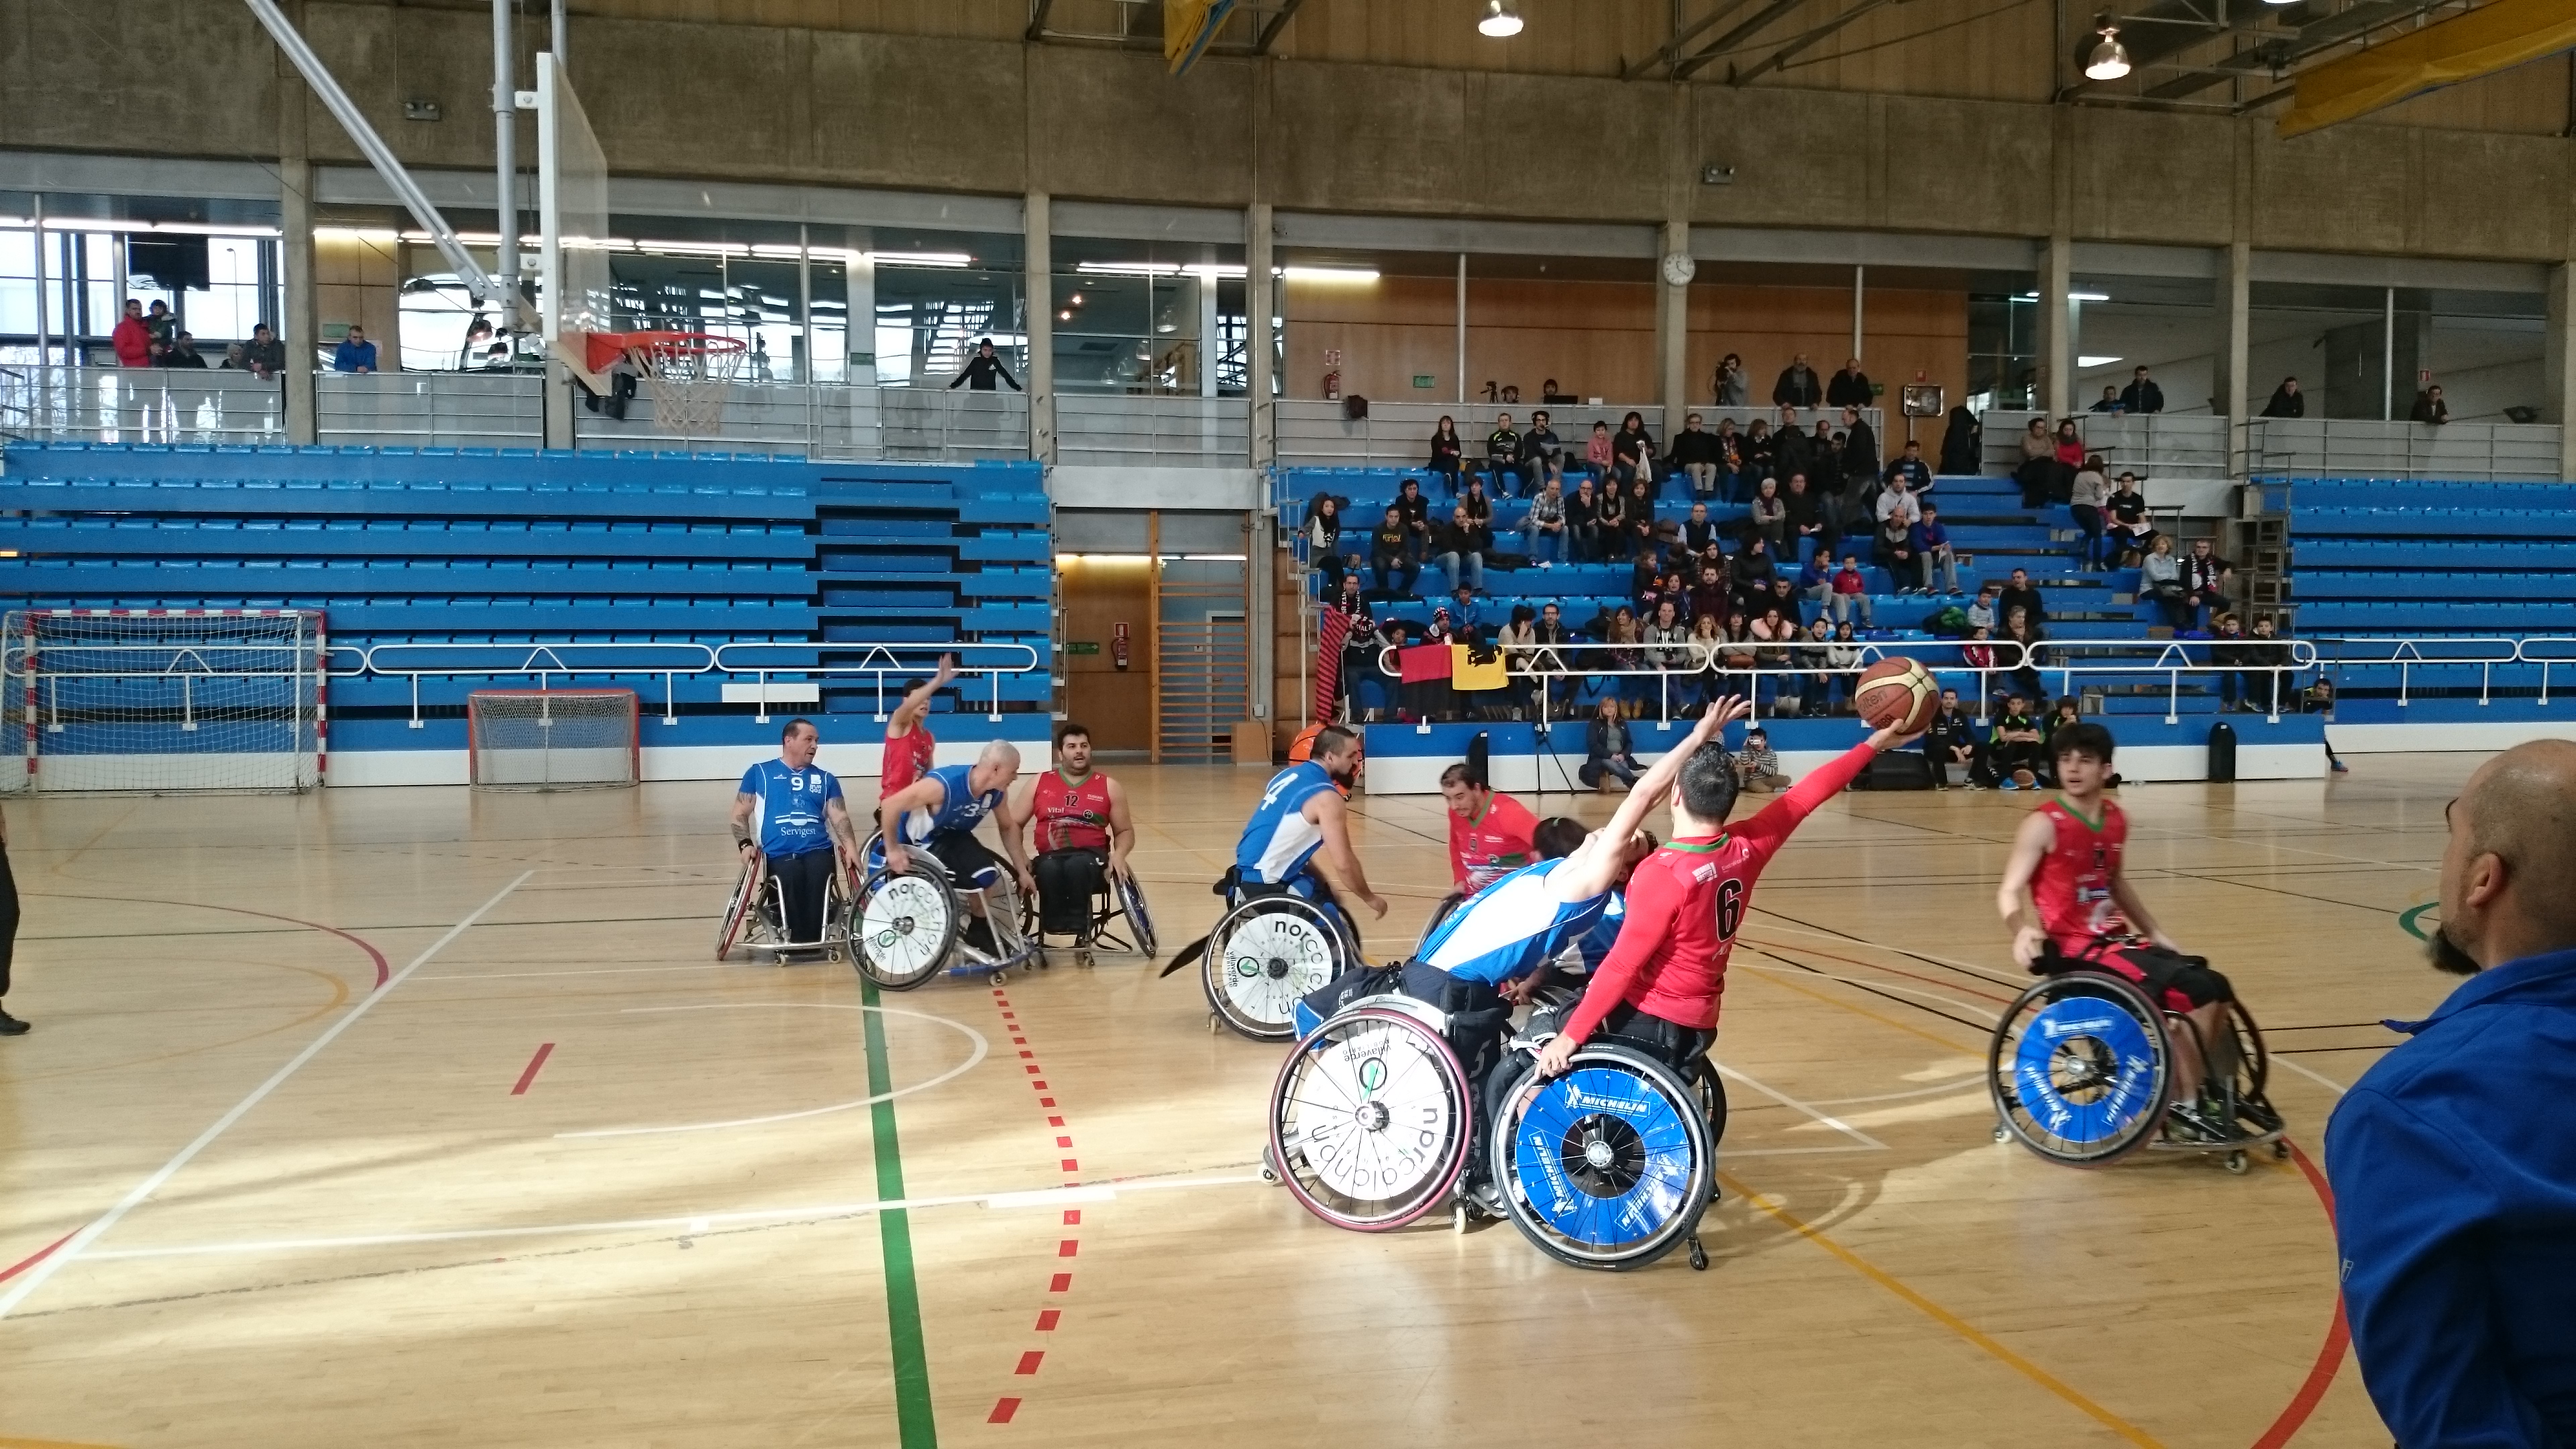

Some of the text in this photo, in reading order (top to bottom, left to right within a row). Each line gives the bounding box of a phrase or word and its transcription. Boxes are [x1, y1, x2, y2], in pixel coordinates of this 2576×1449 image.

[791, 777, 804, 791] 9
[1065, 794, 1079, 807] 12
[1260, 773, 1299, 811] 4
[781, 826, 816, 838] Servigest
[1715, 878, 1743, 943] 6
[1230, 951, 1238, 987] villaverde
[1275, 920, 1324, 1014] norcolcn
[1344, 1044, 1391, 1062] villaverde
[1580, 1095, 1646, 1113] MICHELIN
[1311, 1107, 1438, 1193] norcolchón
[1533, 1136, 1564, 1198] MICHELIN
[1621, 1171, 1664, 1227] MICHELIN
